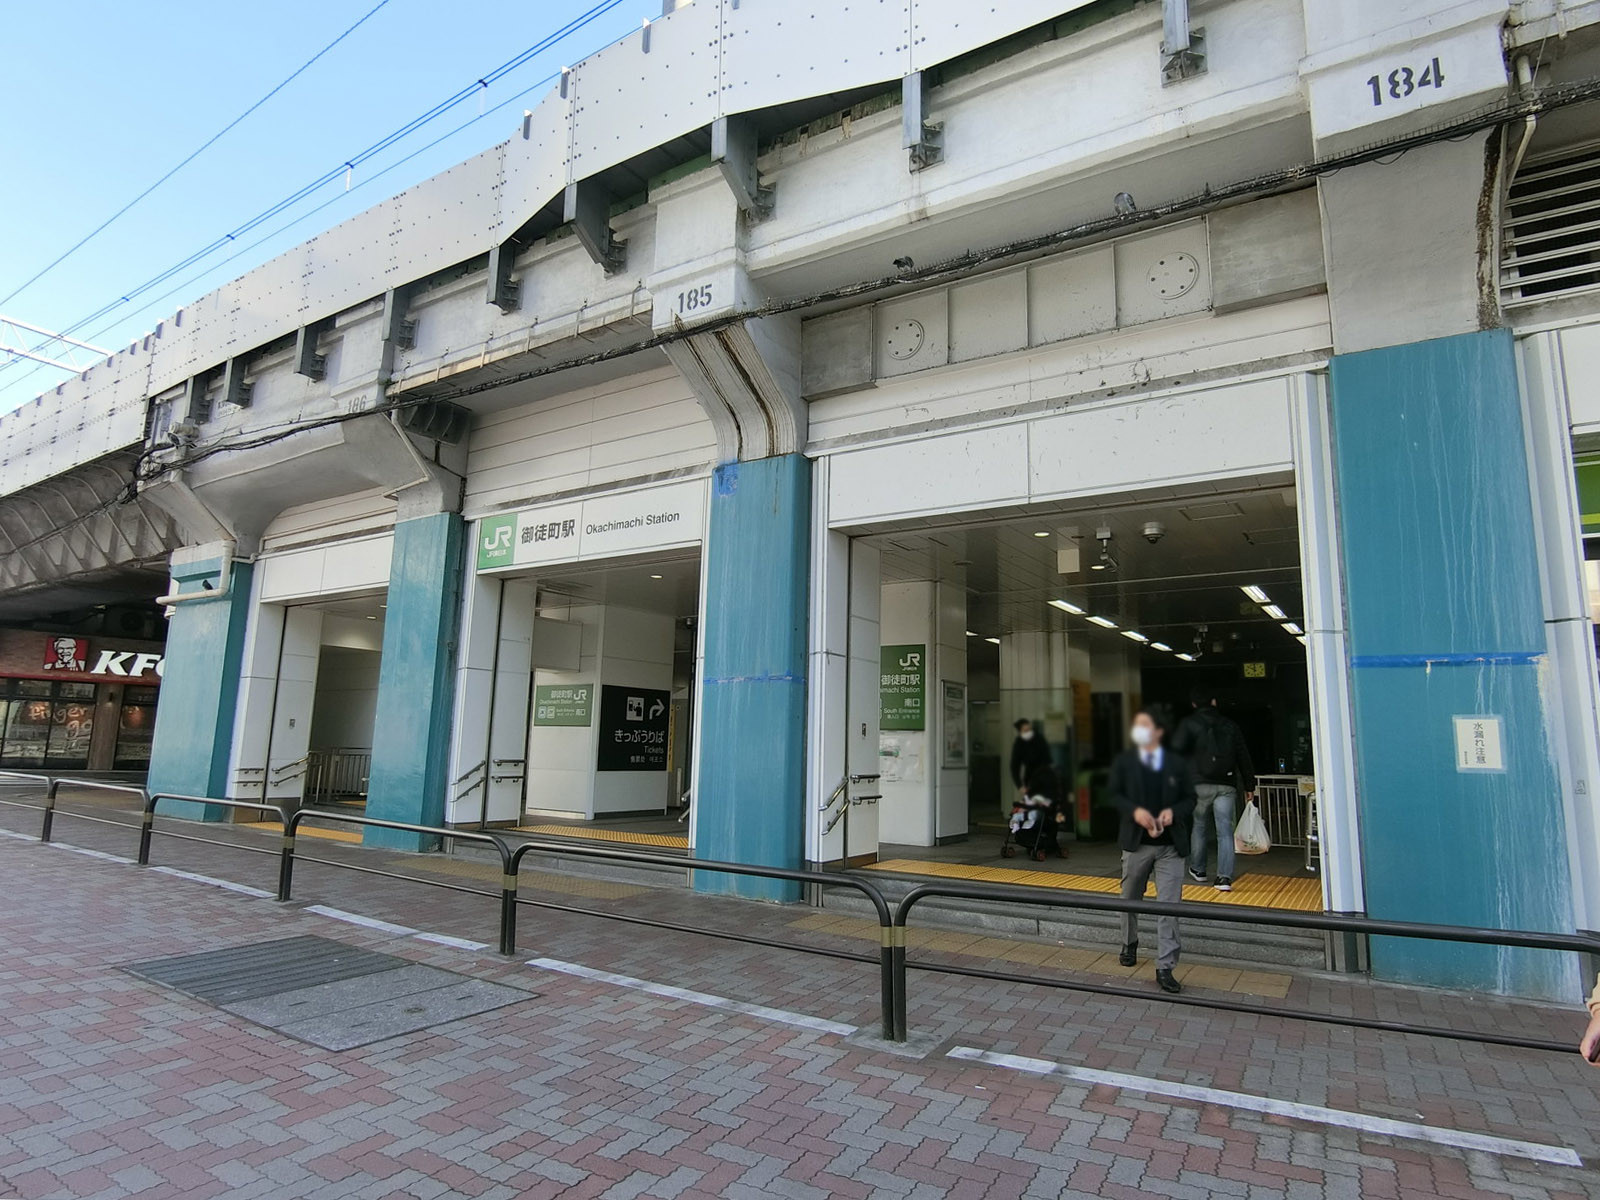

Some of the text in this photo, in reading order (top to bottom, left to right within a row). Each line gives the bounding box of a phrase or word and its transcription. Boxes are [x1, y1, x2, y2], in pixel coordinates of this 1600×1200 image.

[1367, 57, 1445, 106] 184
[678, 283, 713, 313] 185
[348, 394, 367, 413] 186
[521, 519, 575, 544] 御徒町駅
[586, 512, 680, 535] Okachimachi Station
[484, 525, 512, 550] JR
[898, 653, 920, 667] JR
[573, 689, 587, 700] JR
[614, 729, 665, 743] きっぷうりば
